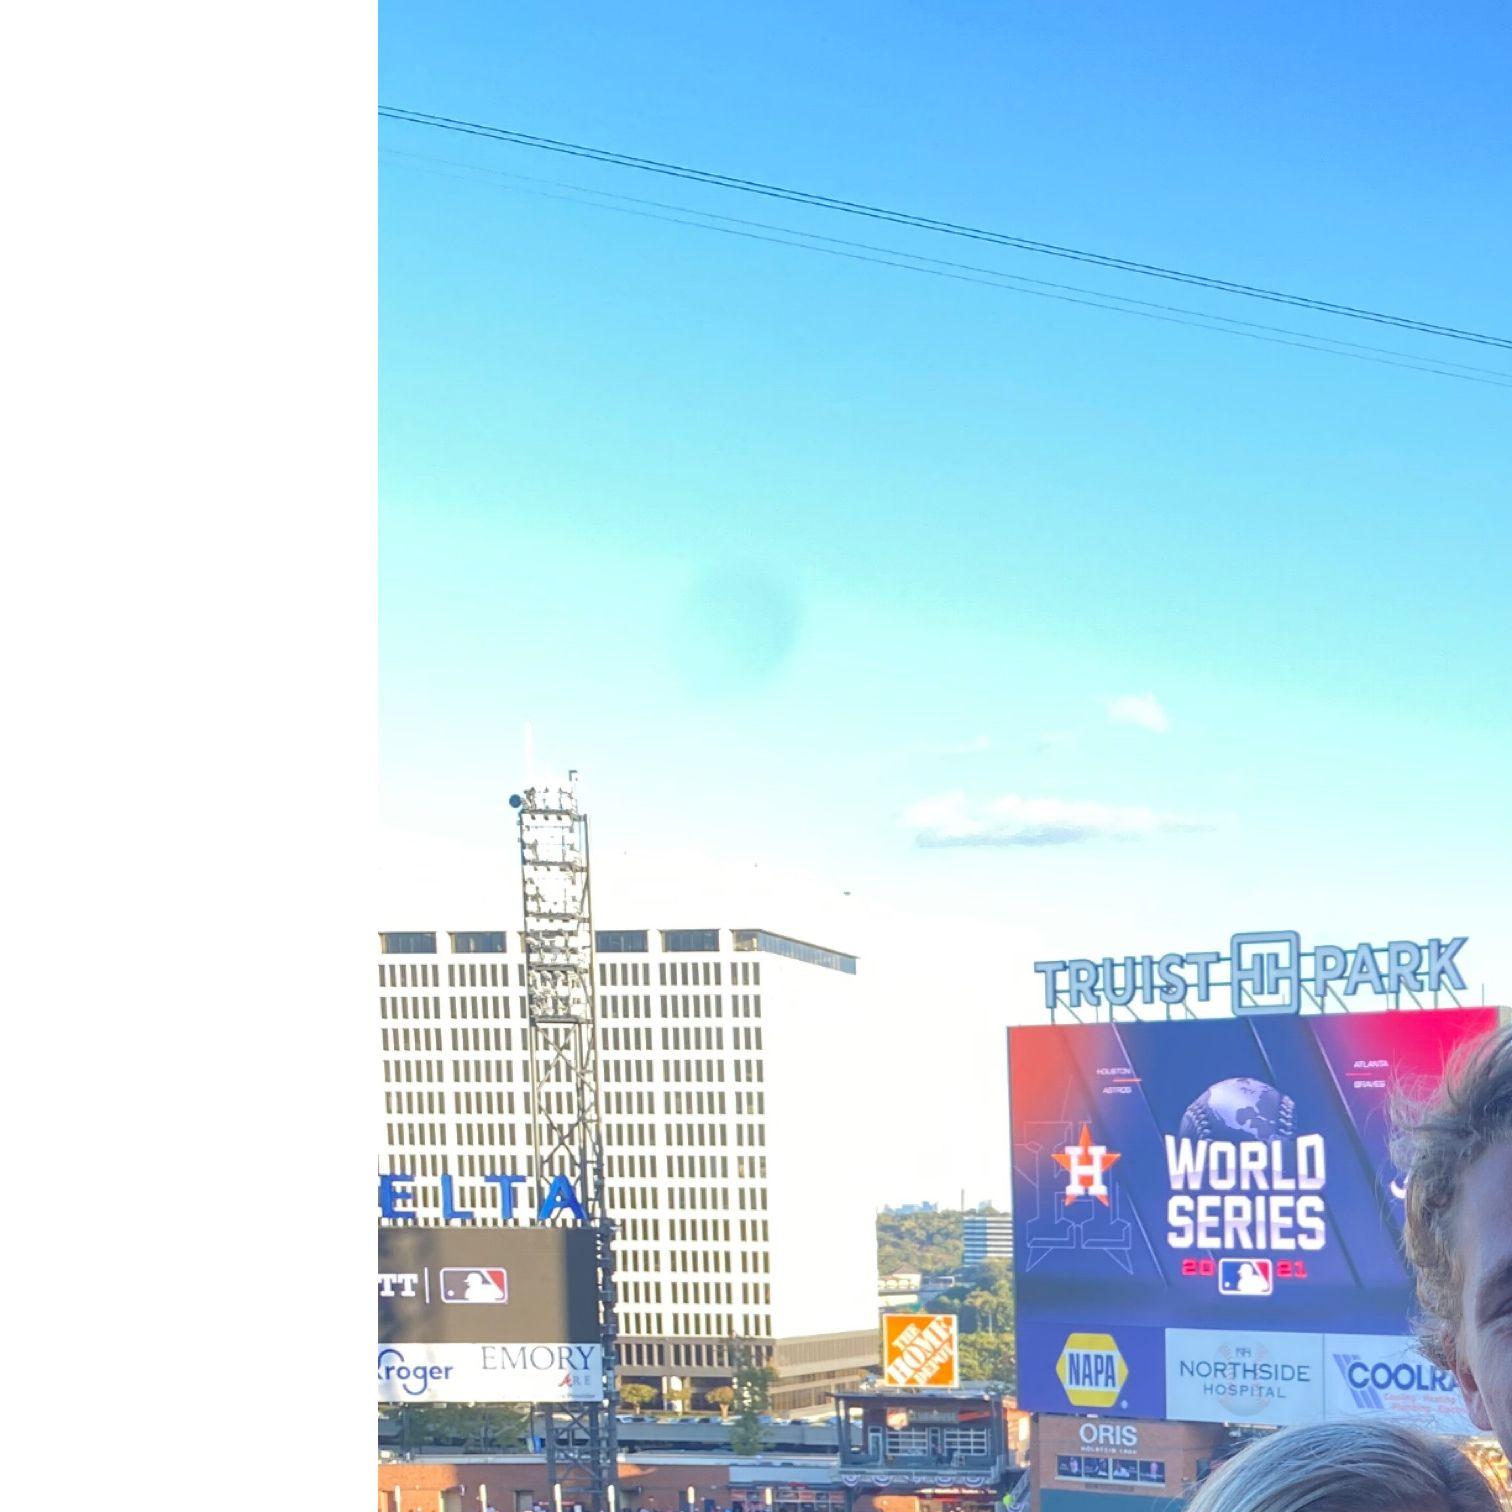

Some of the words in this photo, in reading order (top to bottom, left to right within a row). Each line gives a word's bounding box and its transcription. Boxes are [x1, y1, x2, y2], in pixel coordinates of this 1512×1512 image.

[1034, 951, 1221, 1009] TRUIST
[1314, 936, 1470, 998] PARK
[1353, 1060, 1390, 1068] ATLANTA
[1353, 1080, 1387, 1089] BRAVES
[1165, 1133, 1327, 1191] WORLD
[1166, 1195, 1327, 1251] SERIES
[1181, 1258, 1215, 1277] 20
[1276, 1259, 1308, 1279] 21
[891, 1322, 920, 1351] THE
[481, 1345, 595, 1370] EMORY
[887, 1317, 952, 1384] HOME
[913, 1342, 953, 1384] DEPOT
[1068, 1352, 1117, 1388] NAPA
[1179, 1360, 1311, 1382] NORTHSIDE
[1203, 1383, 1286, 1399] HOSPITAL
[1079, 1422, 1138, 1446] ORIS
